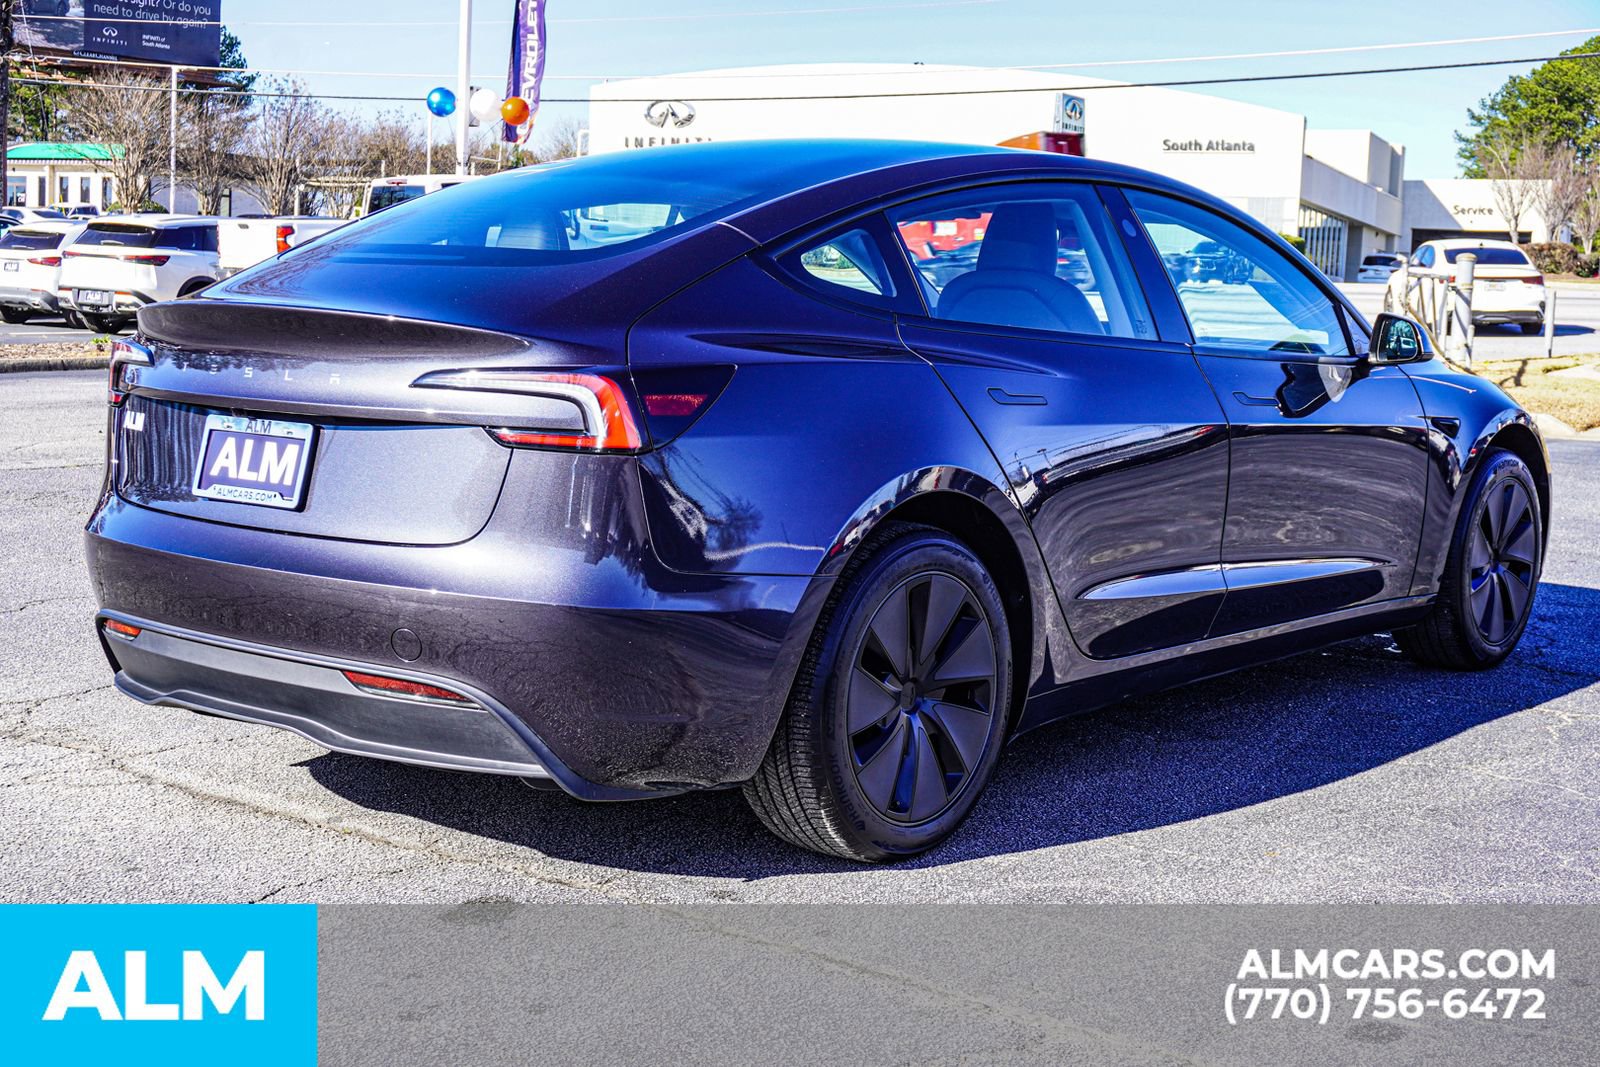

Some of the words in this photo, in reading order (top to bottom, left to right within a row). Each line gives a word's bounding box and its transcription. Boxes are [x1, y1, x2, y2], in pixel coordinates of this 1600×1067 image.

[94, 4, 119, 15] need
[122, 7, 133, 17] to
[135, 8, 160, 20] drive
[162, 11, 175, 26] by
[162, 0, 176, 9] Or
[178, 0, 191, 12] do
[193, 5, 211, 16] you
[93, 37, 128, 46] INFINITI
[1163, 139, 1203, 152] South
[1206, 139, 1255, 152] Atlanta
[1453, 205, 1494, 216] Service
[182, 361, 341, 385] TESLA
[123, 410, 146, 432] ALM
[245, 420, 272, 434] ALM
[209, 437, 300, 486] ALM
